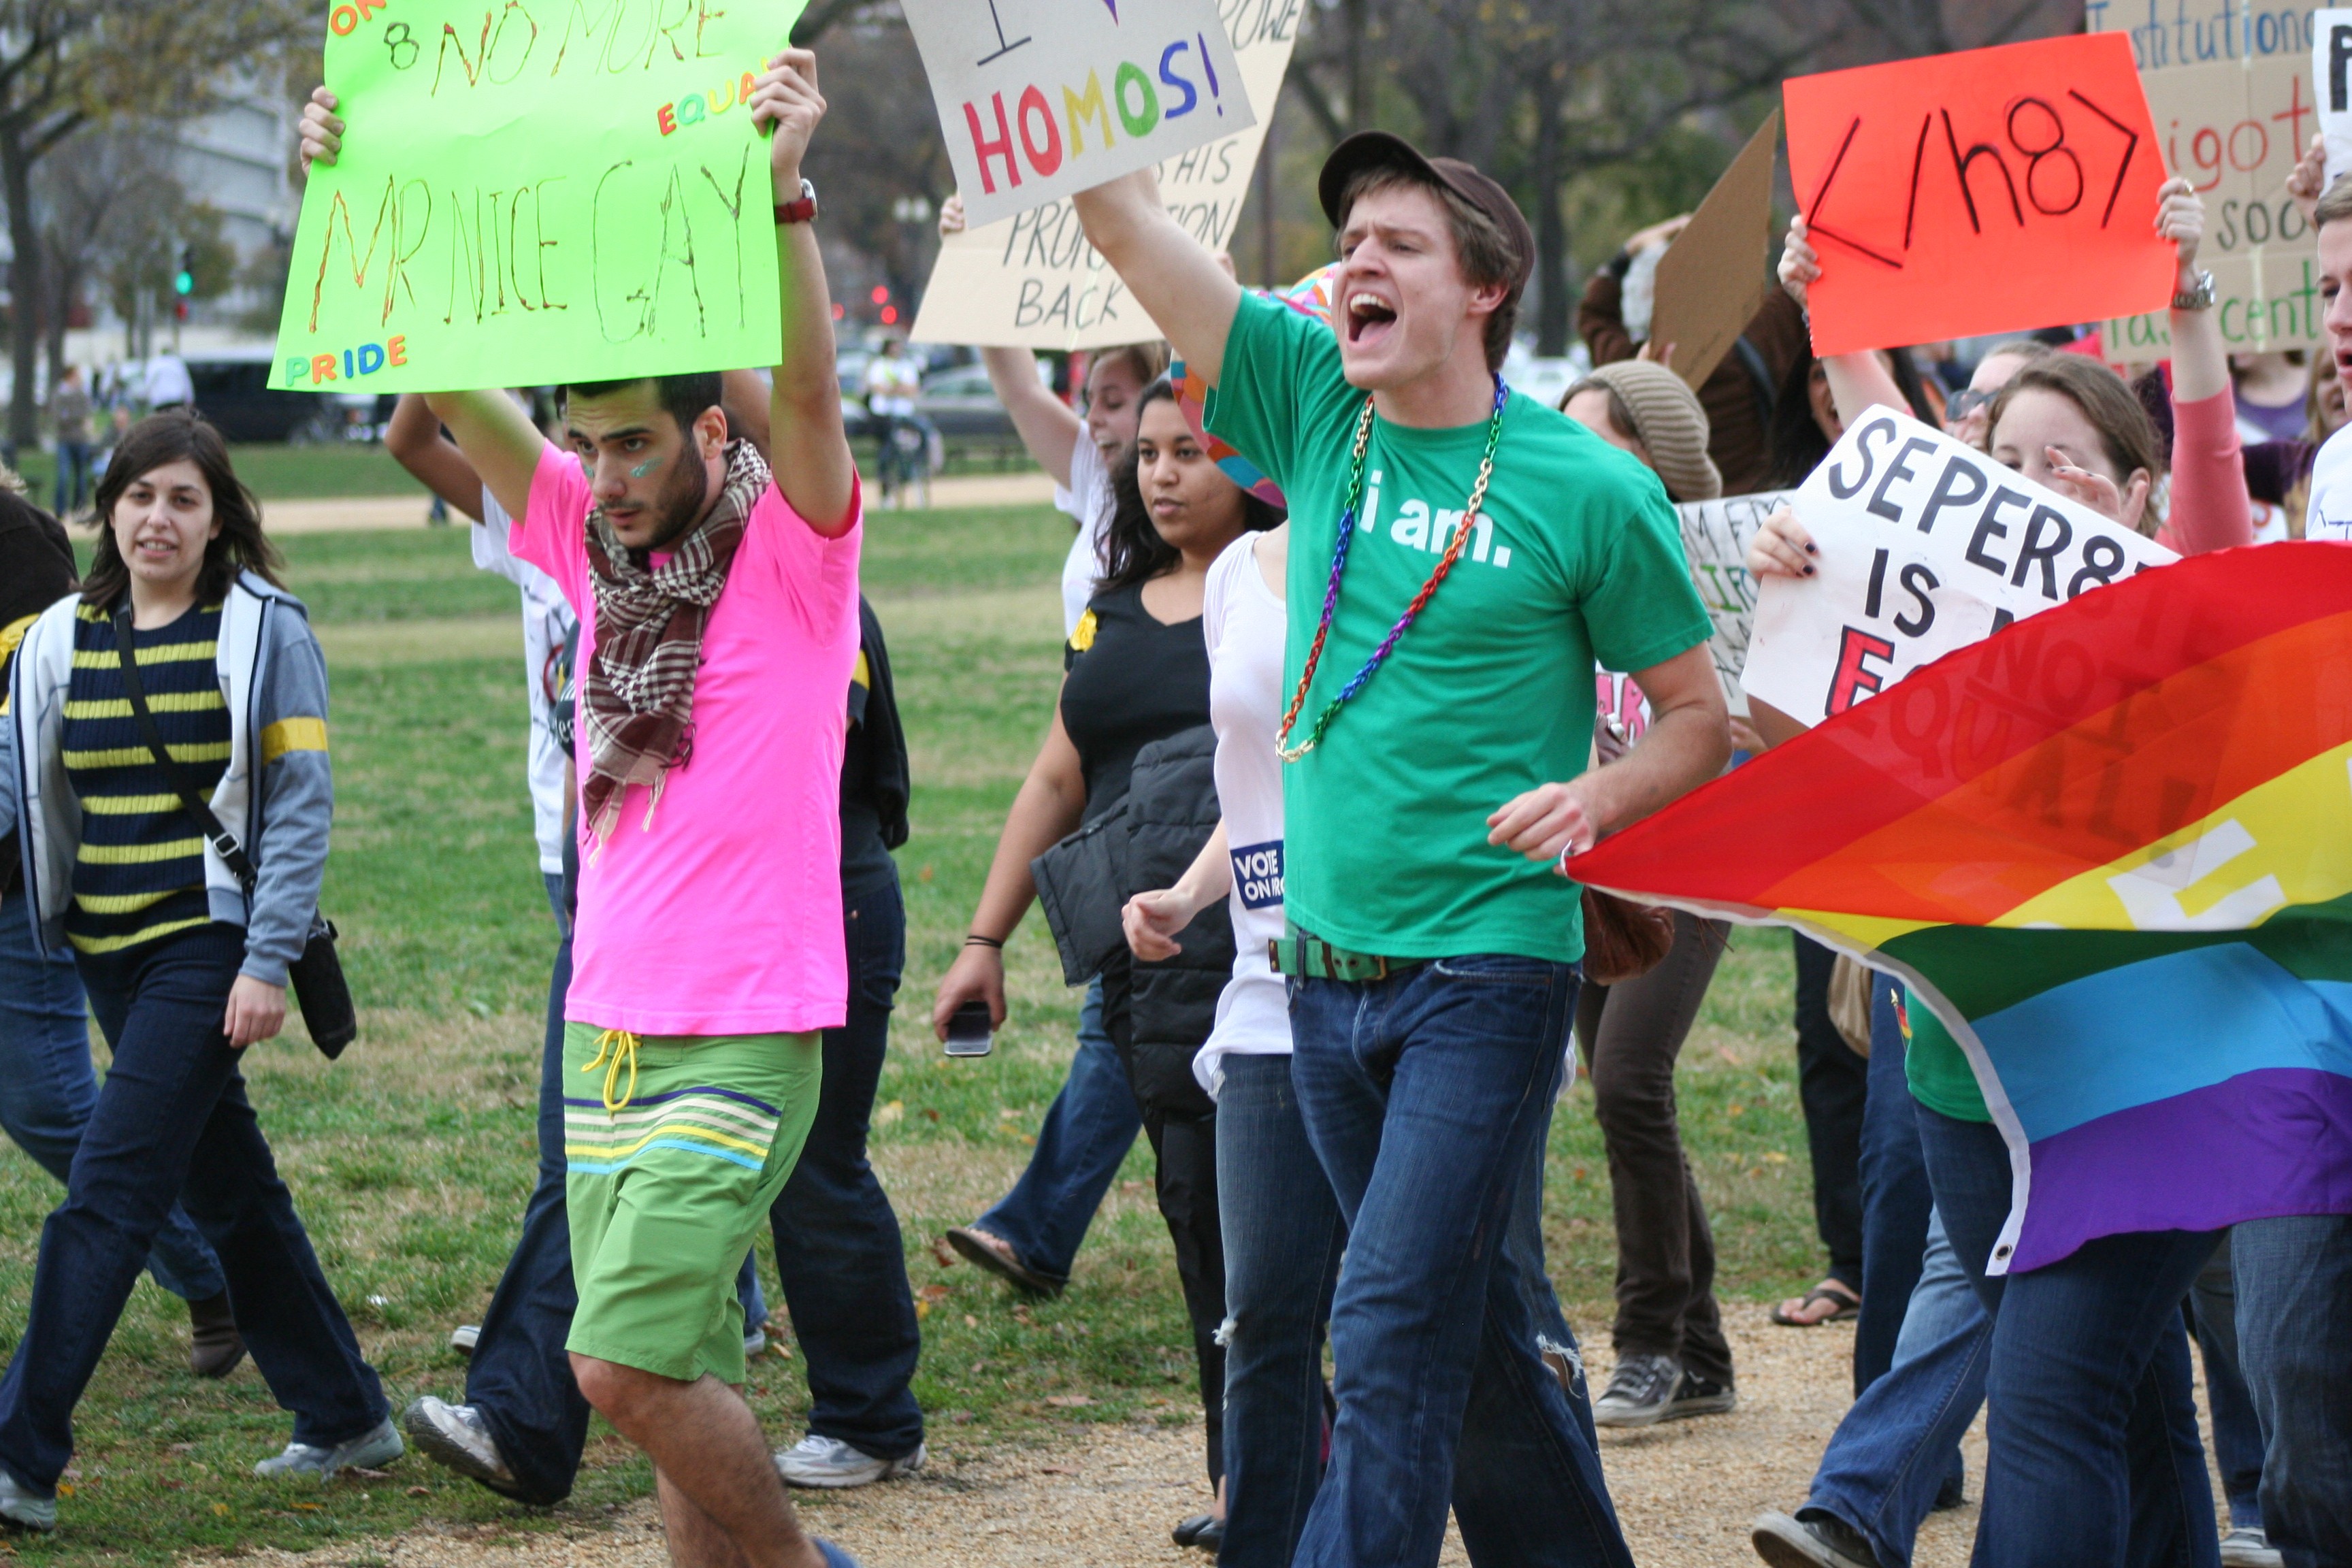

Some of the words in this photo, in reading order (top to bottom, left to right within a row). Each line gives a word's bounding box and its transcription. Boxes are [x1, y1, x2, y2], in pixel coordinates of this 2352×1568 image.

[383, 22, 419, 69] 8
[431, 0, 537, 98] NO
[657, 57, 770, 137] EQUA
[962, 31, 1224, 195] HOMOS!
[2169, 74, 2311, 193] igot
[308, 174, 432, 333] MR
[443, 176, 568, 325] NICE
[593, 142, 751, 344] GAY
[1014, 278, 1124, 330] BACK
[285, 334, 408, 387] PRIDE
[1358, 468, 1383, 534] i
[1390, 497, 1512, 569] am.
[1864, 548, 1940, 638] IS
[1234, 849, 1279, 881] VOTE
[1244, 878, 1271, 902] ON
